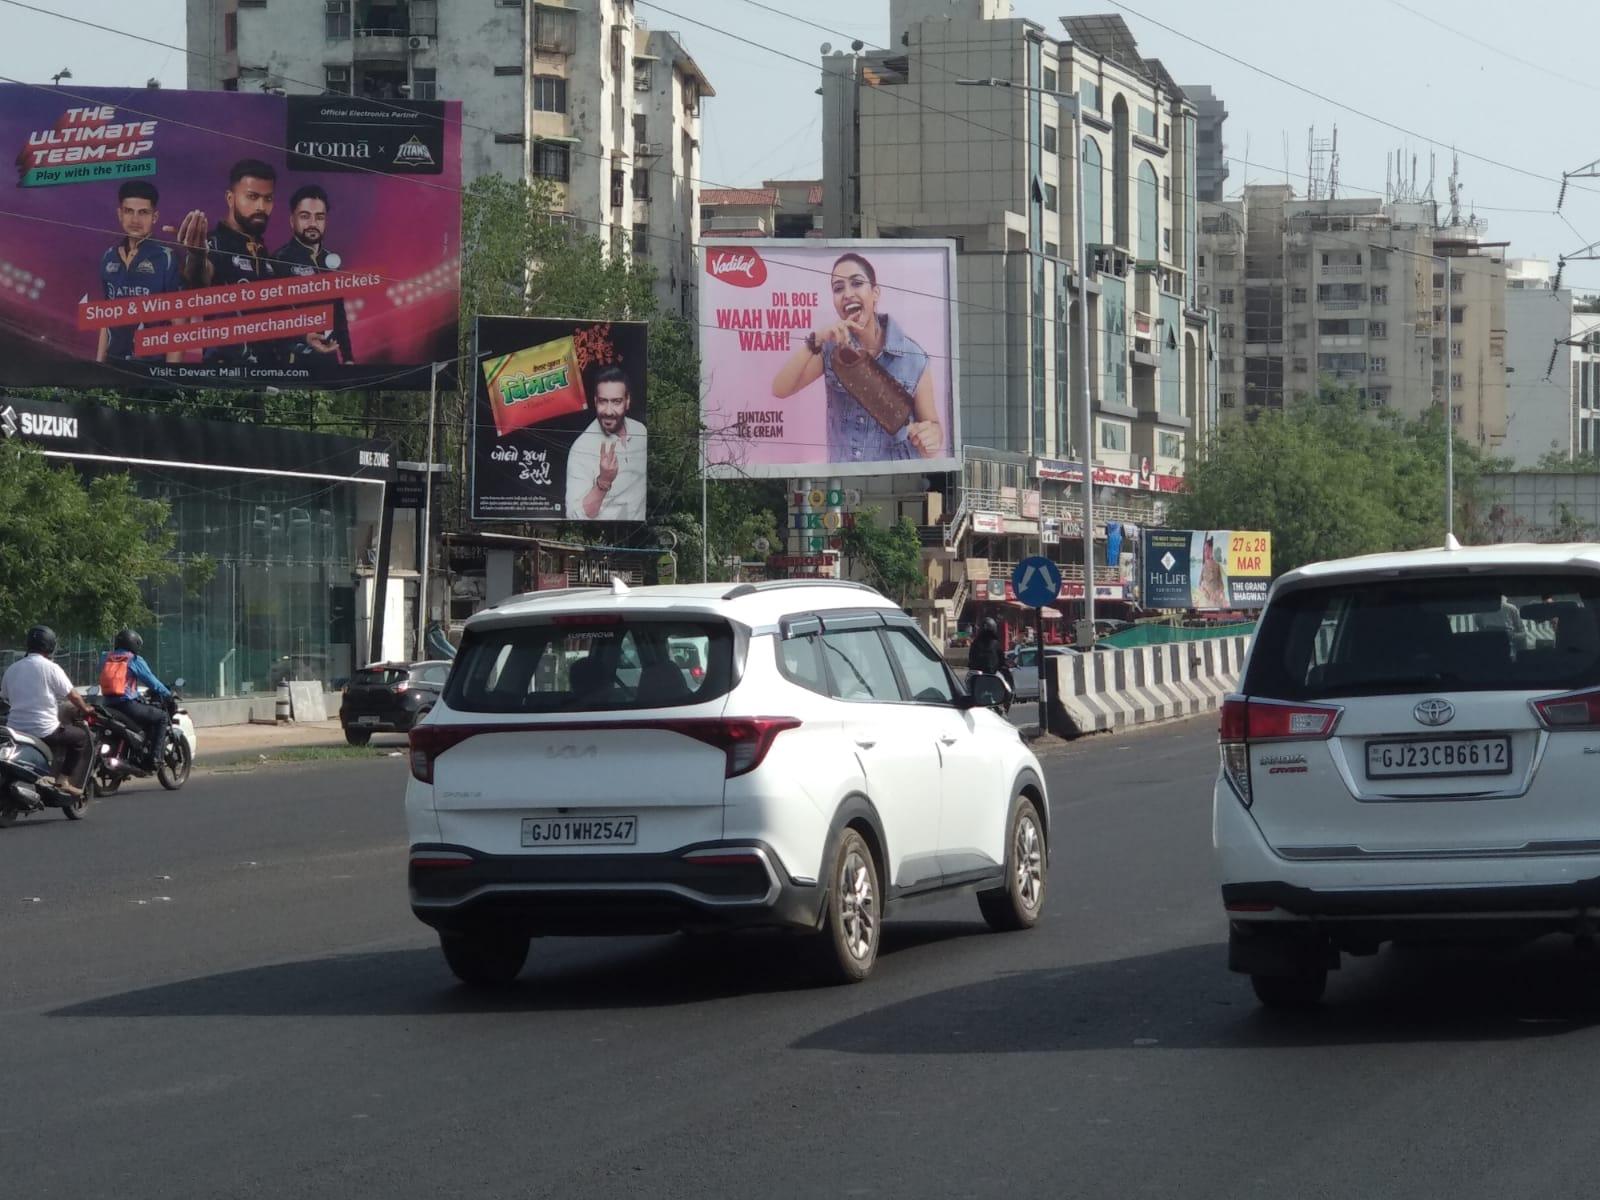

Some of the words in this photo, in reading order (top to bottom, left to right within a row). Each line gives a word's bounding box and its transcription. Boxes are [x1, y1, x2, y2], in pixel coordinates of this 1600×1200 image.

[67, 105, 116, 123] THE
[320, 109, 347, 117] Official
[349, 109, 390, 118] Electronics
[392, 111, 419, 119] Partner
[29, 121, 158, 145] ULTIMATE
[33, 140, 153, 164] TEAM-UP
[36, 168, 61, 181] Play
[65, 166, 89, 178] with
[93, 165, 112, 176] the
[116, 162, 151, 173] Titans
[712, 253, 755, 278] Vadilal
[86, 306, 122, 320] Shop
[128, 303, 137, 315] &
[142, 298, 170, 312] Win
[175, 300, 183, 309] a
[187, 292, 237, 308] chance
[241, 289, 255, 301] to
[260, 286, 283, 301] get
[288, 279, 330, 296] match
[335, 273, 380, 289] tickets
[772, 292, 789, 307] DIL
[792, 292, 818, 307] BOLE
[716, 309, 762, 329] WAAH
[766, 309, 811, 329] WAAH
[142, 332, 168, 347] and
[173, 325, 229, 343] exciting
[233, 312, 326, 335] merchandise!
[739, 331, 790, 351] WAAH!
[150, 367, 176, 377] Visit:
[179, 367, 216, 377] Devarc
[219, 367, 241, 377] Mall
[250, 368, 309, 377] croma.com
[21, 413, 78, 438] SUZUKI
[737, 411, 784, 424] FUNTASTIC
[753, 425, 783, 438] CREAM
[374, 452, 389, 468] ZONE
[1232, 538, 1244, 552] 27
[1245, 541, 1251, 552] &
[1254, 538, 1266, 552] 28
[1237, 557, 1261, 570] MAR
[1232, 582, 1244, 591] THE
[1245, 582, 1267, 591] GRAND
[1383, 744, 1505, 767] GJ23CB6612
[532, 822, 633, 841] GJ01WH2547
